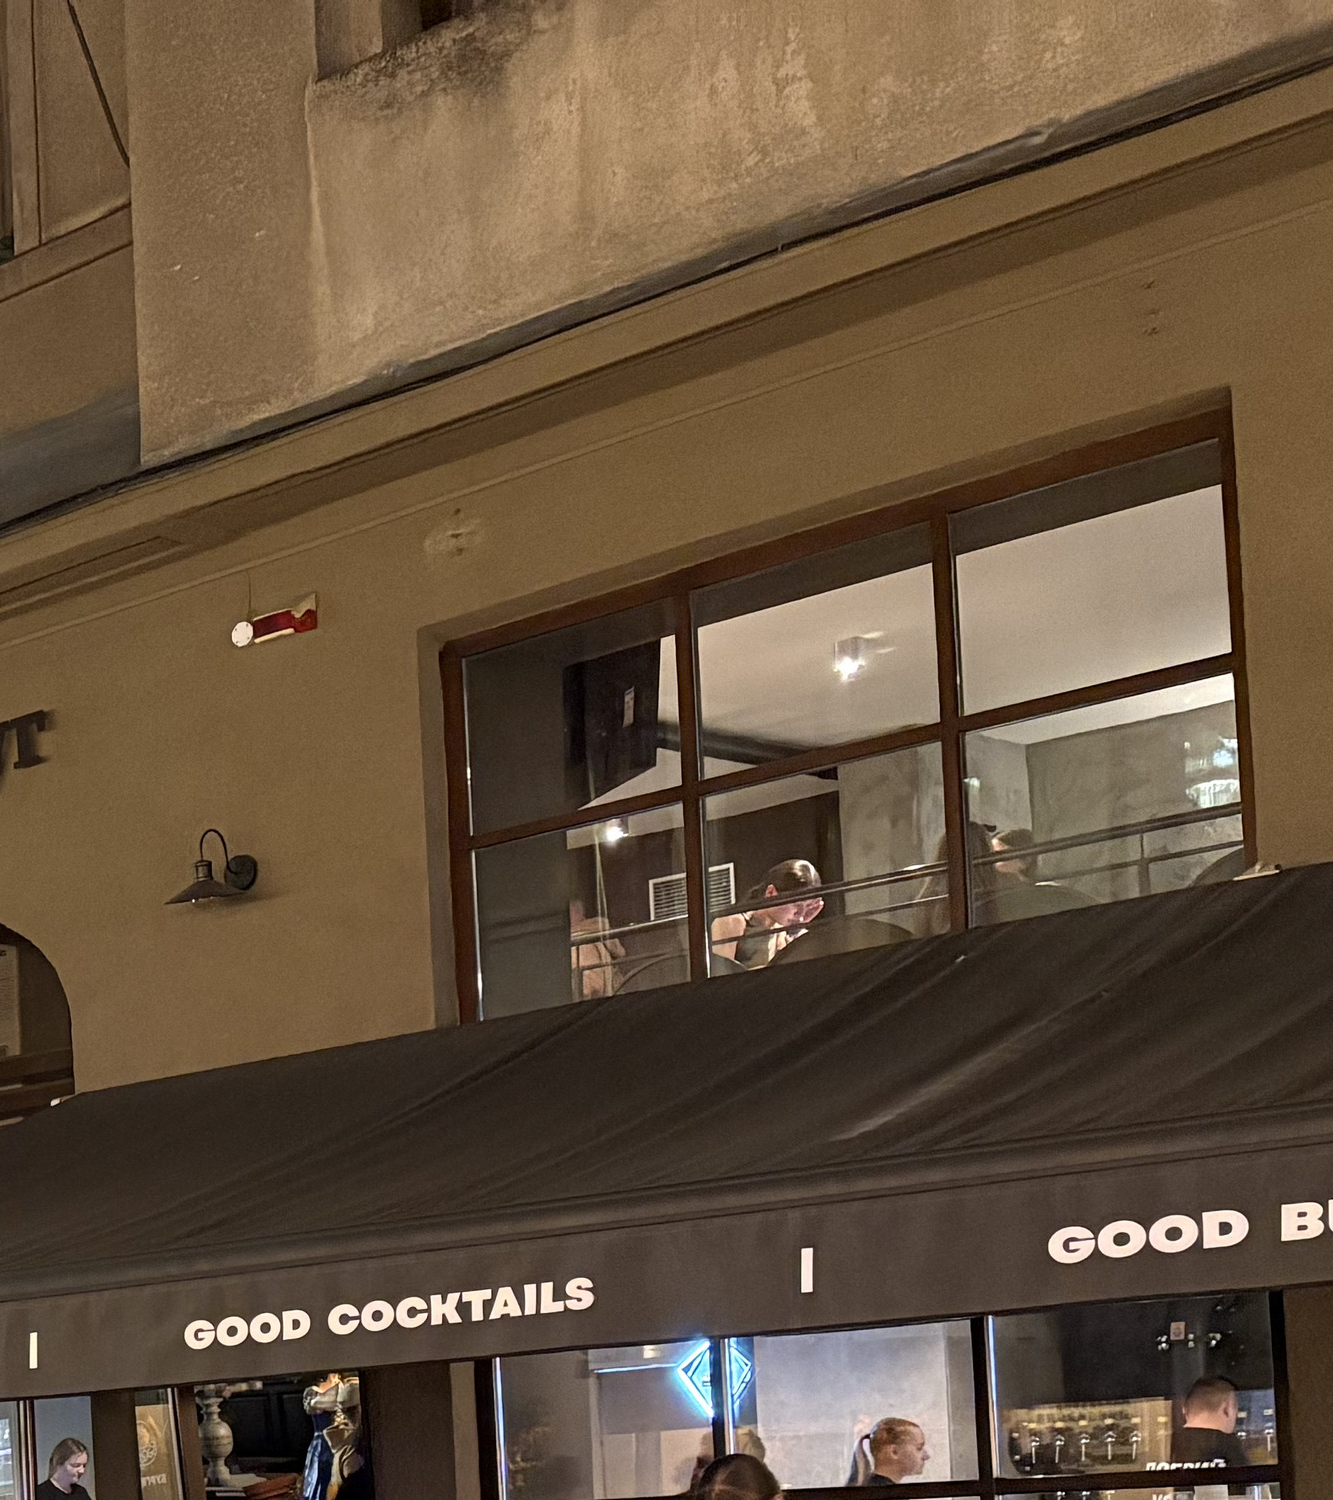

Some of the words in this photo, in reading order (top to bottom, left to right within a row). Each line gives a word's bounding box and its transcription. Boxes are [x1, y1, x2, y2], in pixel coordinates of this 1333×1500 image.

[1047, 1209, 1250, 1265] GOOD
[183, 1309, 312, 1351] GOOD
[326, 1276, 596, 1336] COCKTAILS
